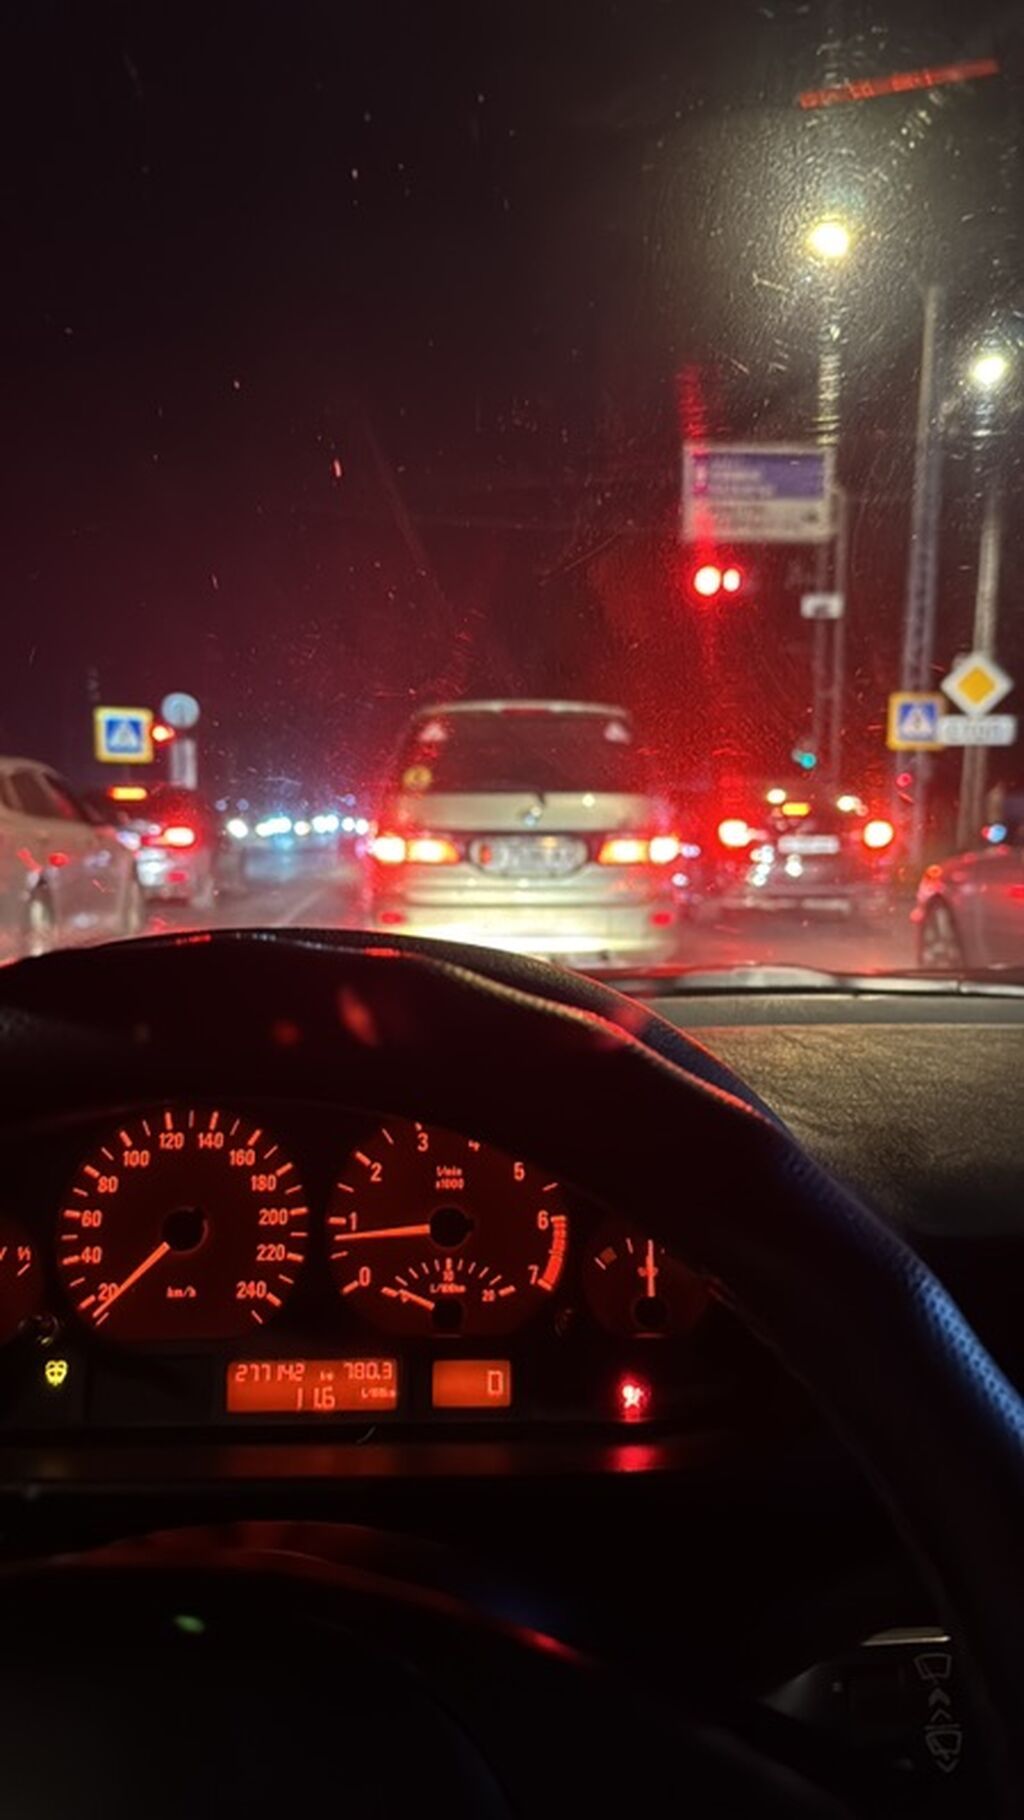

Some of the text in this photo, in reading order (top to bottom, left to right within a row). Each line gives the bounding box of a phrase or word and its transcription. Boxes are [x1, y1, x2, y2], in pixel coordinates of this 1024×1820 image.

[158, 1132, 185, 1150] 120
[198, 1132, 224, 1149] 140
[417, 1132, 429, 1151] 3
[123, 1150, 151, 1167] 100
[229, 1149, 256, 1167] 160
[370, 1162, 383, 1182] 2
[513, 1161, 525, 1181] 5
[97, 1176, 119, 1193] 80
[250, 1174, 277, 1191] 180
[81, 1210, 102, 1228] 60
[258, 1208, 288, 1226] 200
[349, 1211, 357, 1231] 1
[537, 1210, 549, 1230] 6
[81, 1246, 103, 1264] 40
[256, 1244, 286, 1261] 220
[358, 1266, 371, 1287] 0
[528, 1264, 540, 1285] 7
[98, 1282, 120, 1301] 20
[236, 1281, 268, 1299] 240
[486, 1369, 504, 1396] 0
